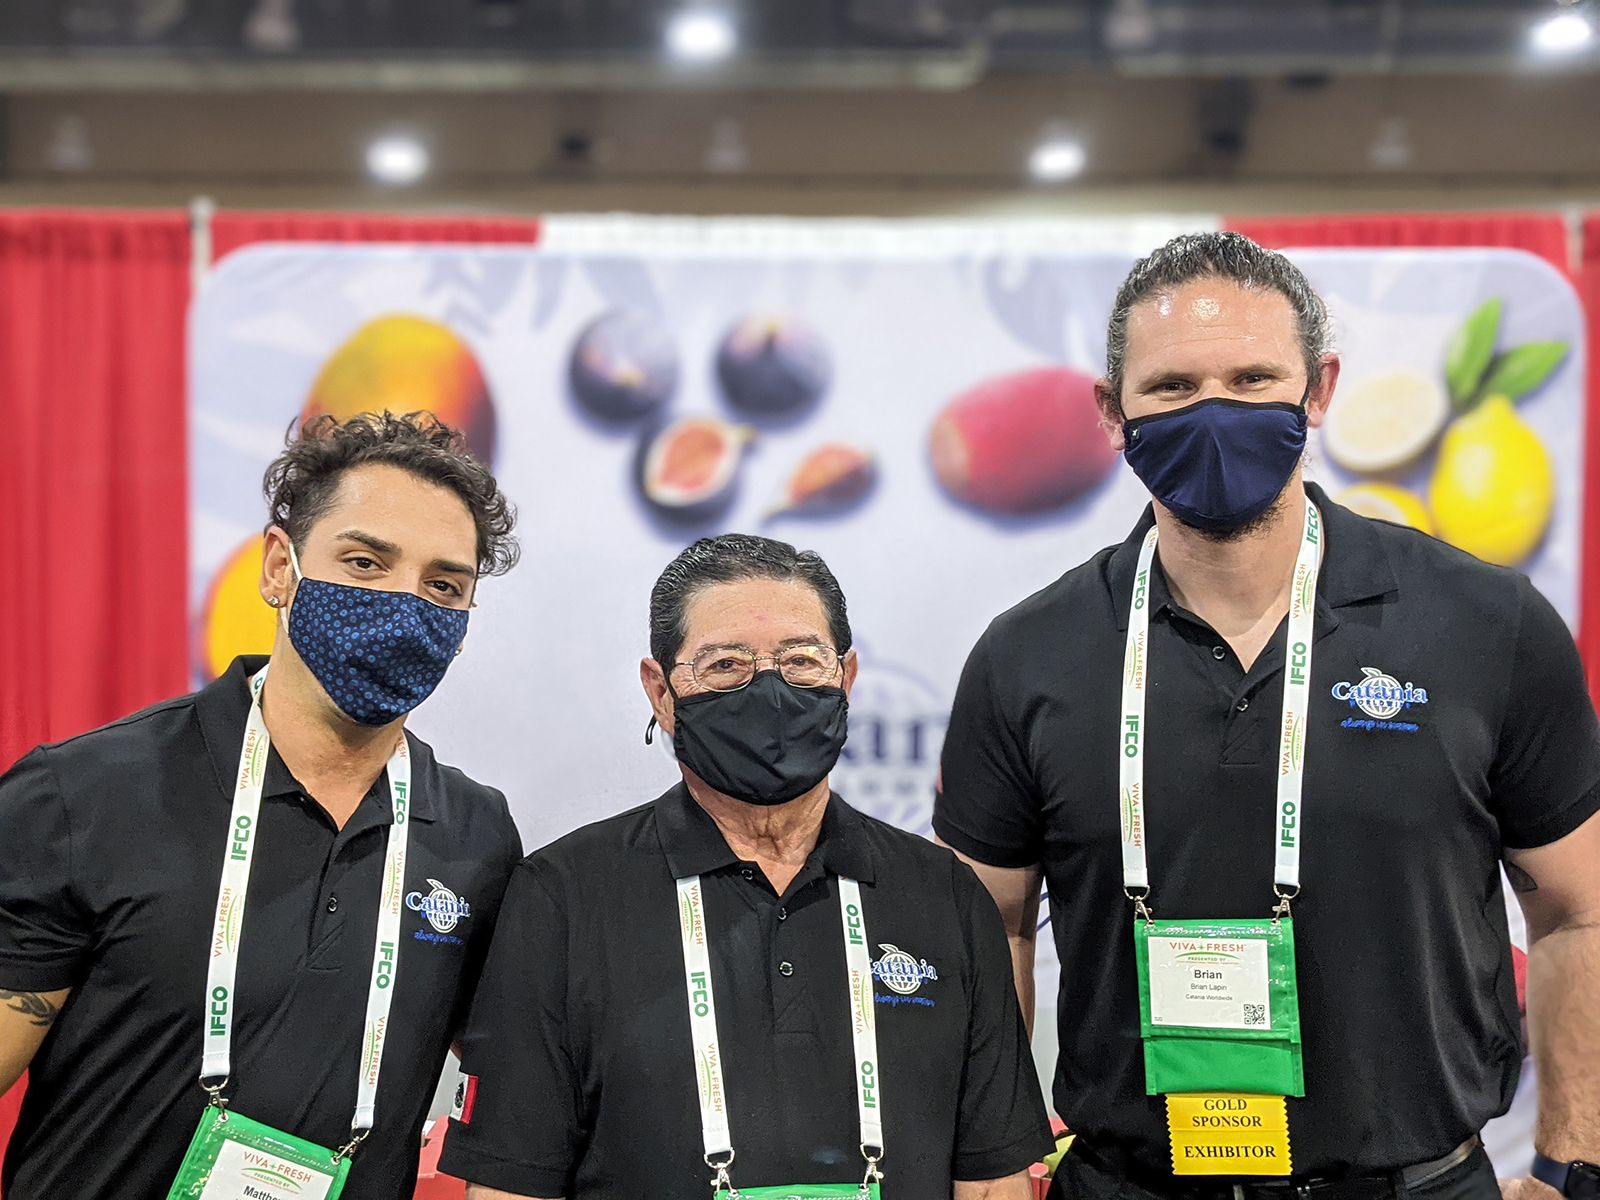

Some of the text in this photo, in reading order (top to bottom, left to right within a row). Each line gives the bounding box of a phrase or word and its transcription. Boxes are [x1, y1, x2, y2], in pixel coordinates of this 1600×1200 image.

[1306, 507, 1318, 545] IFCO
[1134, 569, 1147, 610] IFCO
[1290, 641, 1307, 685] IFCO
[1331, 681, 1428, 703] Catania
[1124, 714, 1139, 758] IFCO
[394, 781, 406, 825] IFCO
[230, 815, 252, 861] IFCO
[1281, 801, 1296, 848] IFCO
[846, 903, 863, 945] IFCO
[376, 941, 394, 989] IFCO
[870, 958, 938, 980] atania
[1194, 969, 1222, 979] Brian
[691, 970, 709, 1017] IFCO
[1190, 982, 1227, 991] Brian Lapin
[210, 986, 228, 1036] IFCO
[861, 1060, 876, 1108] IFCO
[1203, 1098, 1247, 1110] GOLD
[1192, 1115, 1262, 1127] SPONSOR
[1184, 1145, 1276, 1158] EXHIBITOR
